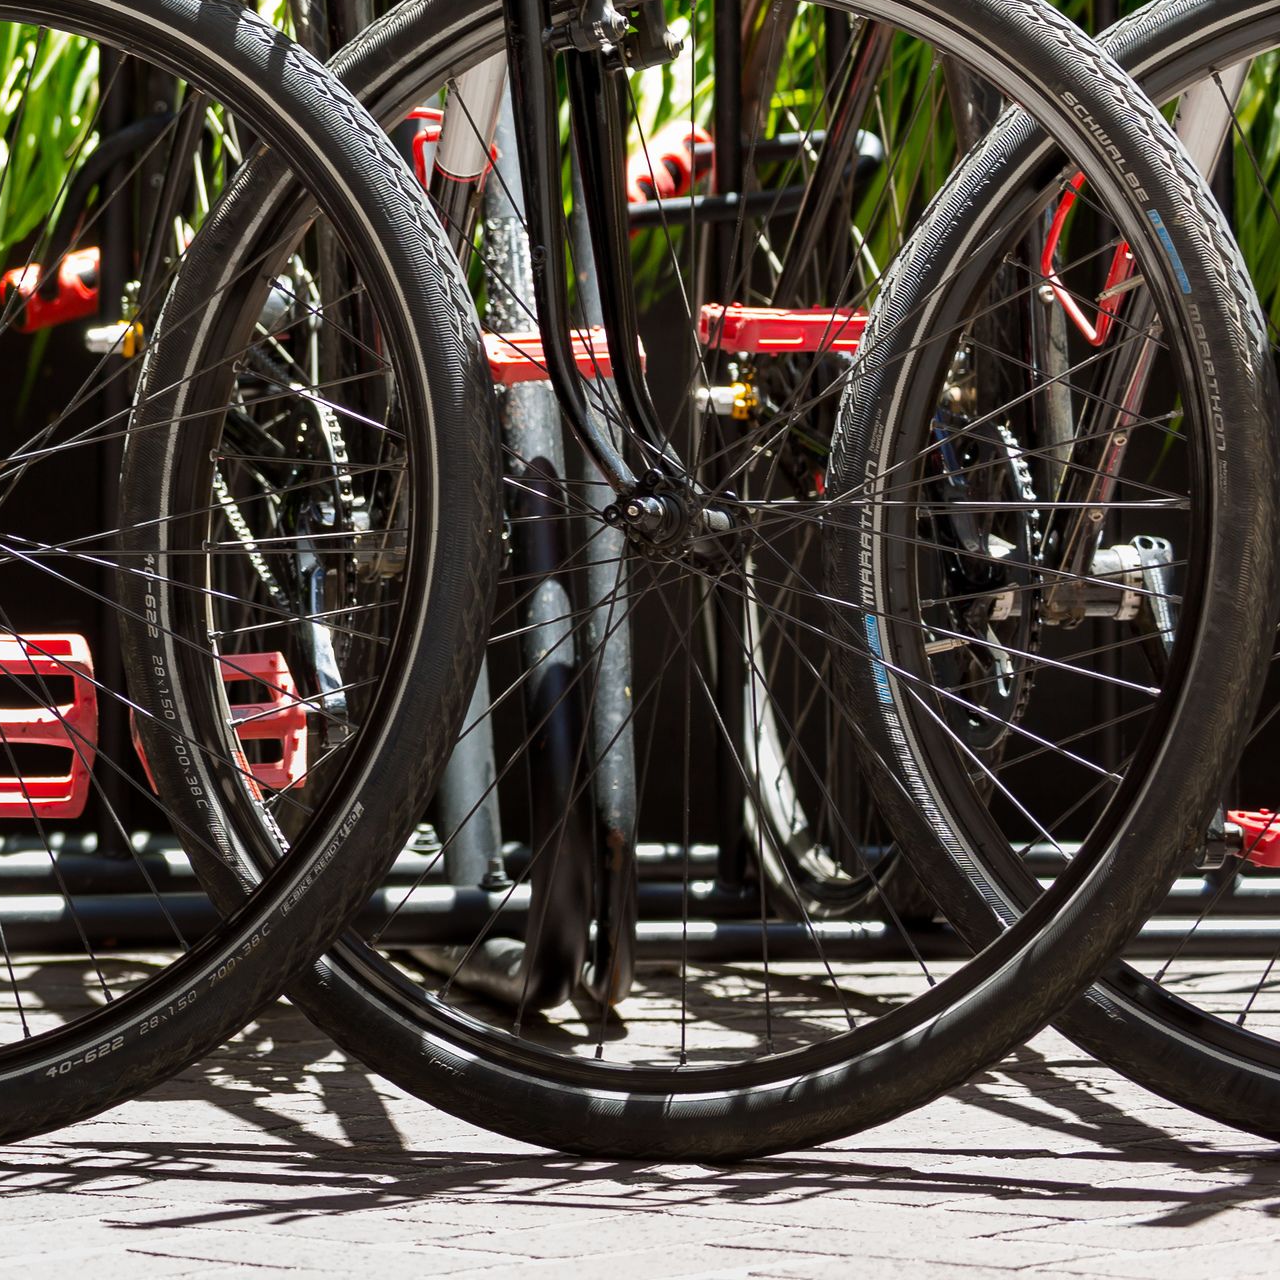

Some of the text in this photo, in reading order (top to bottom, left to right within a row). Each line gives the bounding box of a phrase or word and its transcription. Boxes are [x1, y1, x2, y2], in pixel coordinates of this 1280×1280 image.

[1059, 90, 1227, 452] SCHWALBE MARATHON
[142, 553, 159, 639] 40-622
[45, 1034, 125, 1079] 40-622
